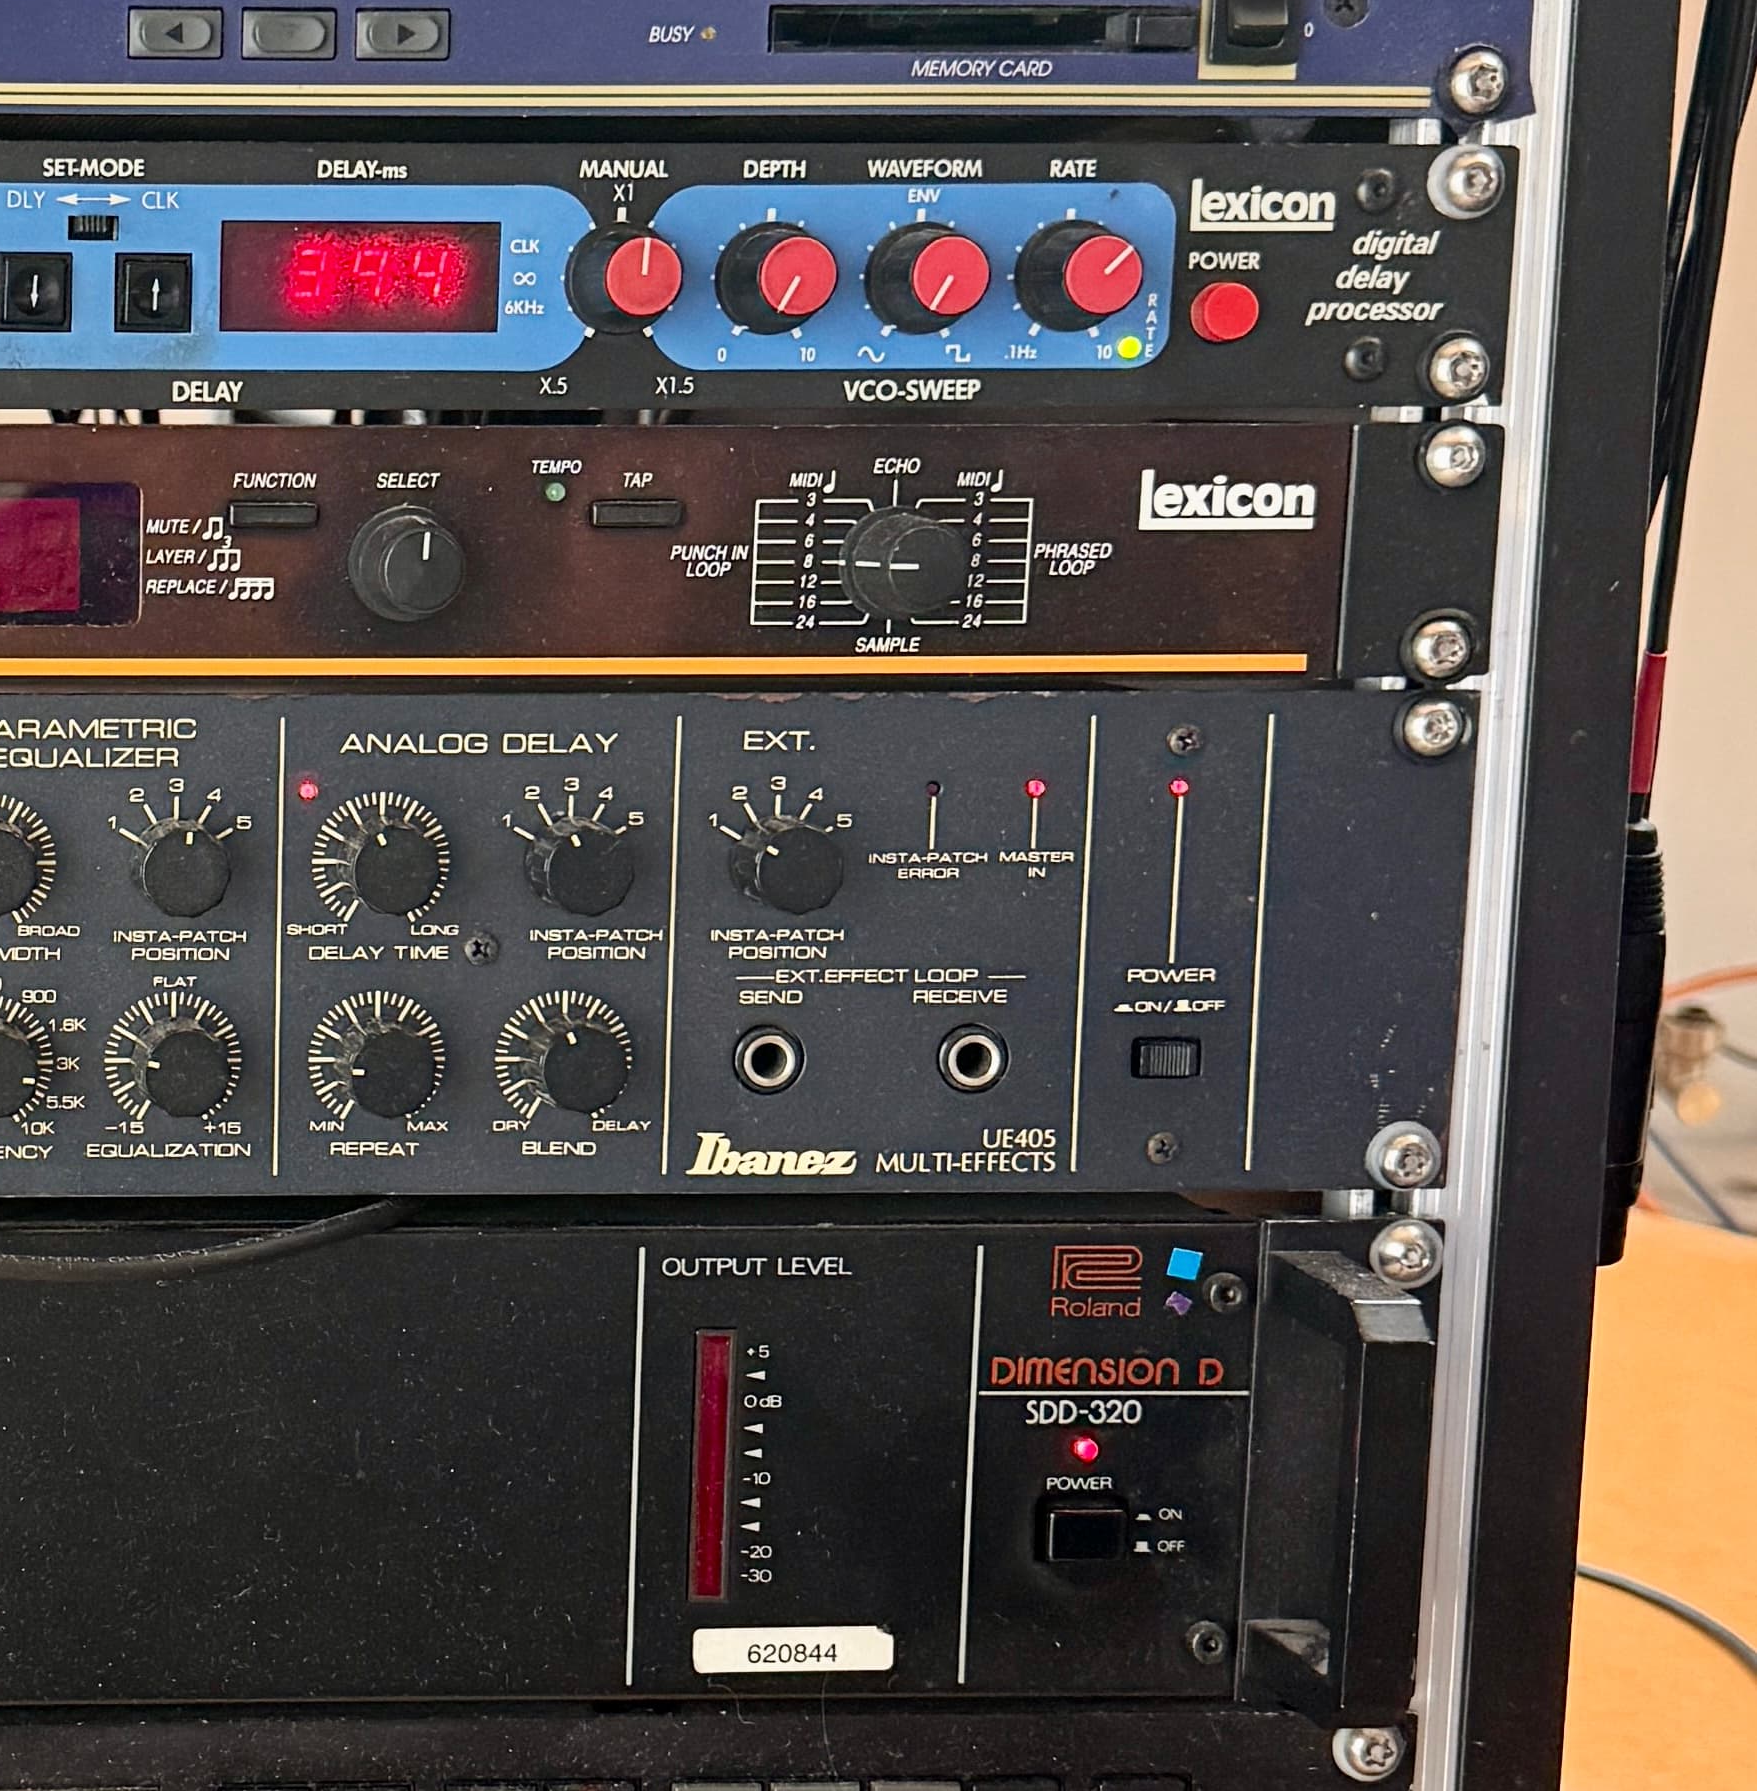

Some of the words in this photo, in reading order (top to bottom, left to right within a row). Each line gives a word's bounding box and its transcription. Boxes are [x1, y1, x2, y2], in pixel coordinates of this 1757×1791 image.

[649, 26, 694, 43] BUSY
[912, 60, 996, 77] MEMORY
[999, 60, 1052, 77] CARD
[43, 159, 144, 178] SET-MODE
[317, 160, 407, 180] DELAY-ms
[867, 159, 982, 179] WAVEFORM
[1352, 229, 1439, 259] digital
[1336, 265, 1409, 294] delay
[1305, 298, 1442, 326] processor
[843, 379, 980, 402] VCO-SWEEP
[233, 473, 317, 489] FUNCTION
[376, 473, 440, 489] SELECT
[855, 637, 920, 654] SAMPLE
[340, 734, 488, 754] ANALOG
[502, 733, 618, 754] DELAY
[744, 731, 815, 751] EXT.
[982, 1129, 1056, 1148] UE405
[330, 1142, 419, 1157] REPEAT
[687, 1132, 857, 1176] Ibanez
[875, 1152, 1056, 1173] MULTI-EFFECTS
[661, 1257, 767, 1276] OUTPUT
[777, 1256, 852, 1276] LEVEL
[1051, 1297, 1141, 1317] Roland
[991, 1358, 1180, 1386] DIMENSION
[1199, 1359, 1224, 1385] D
[1025, 1400, 1141, 1425] SDD-320
[747, 1642, 838, 1664] 620844
